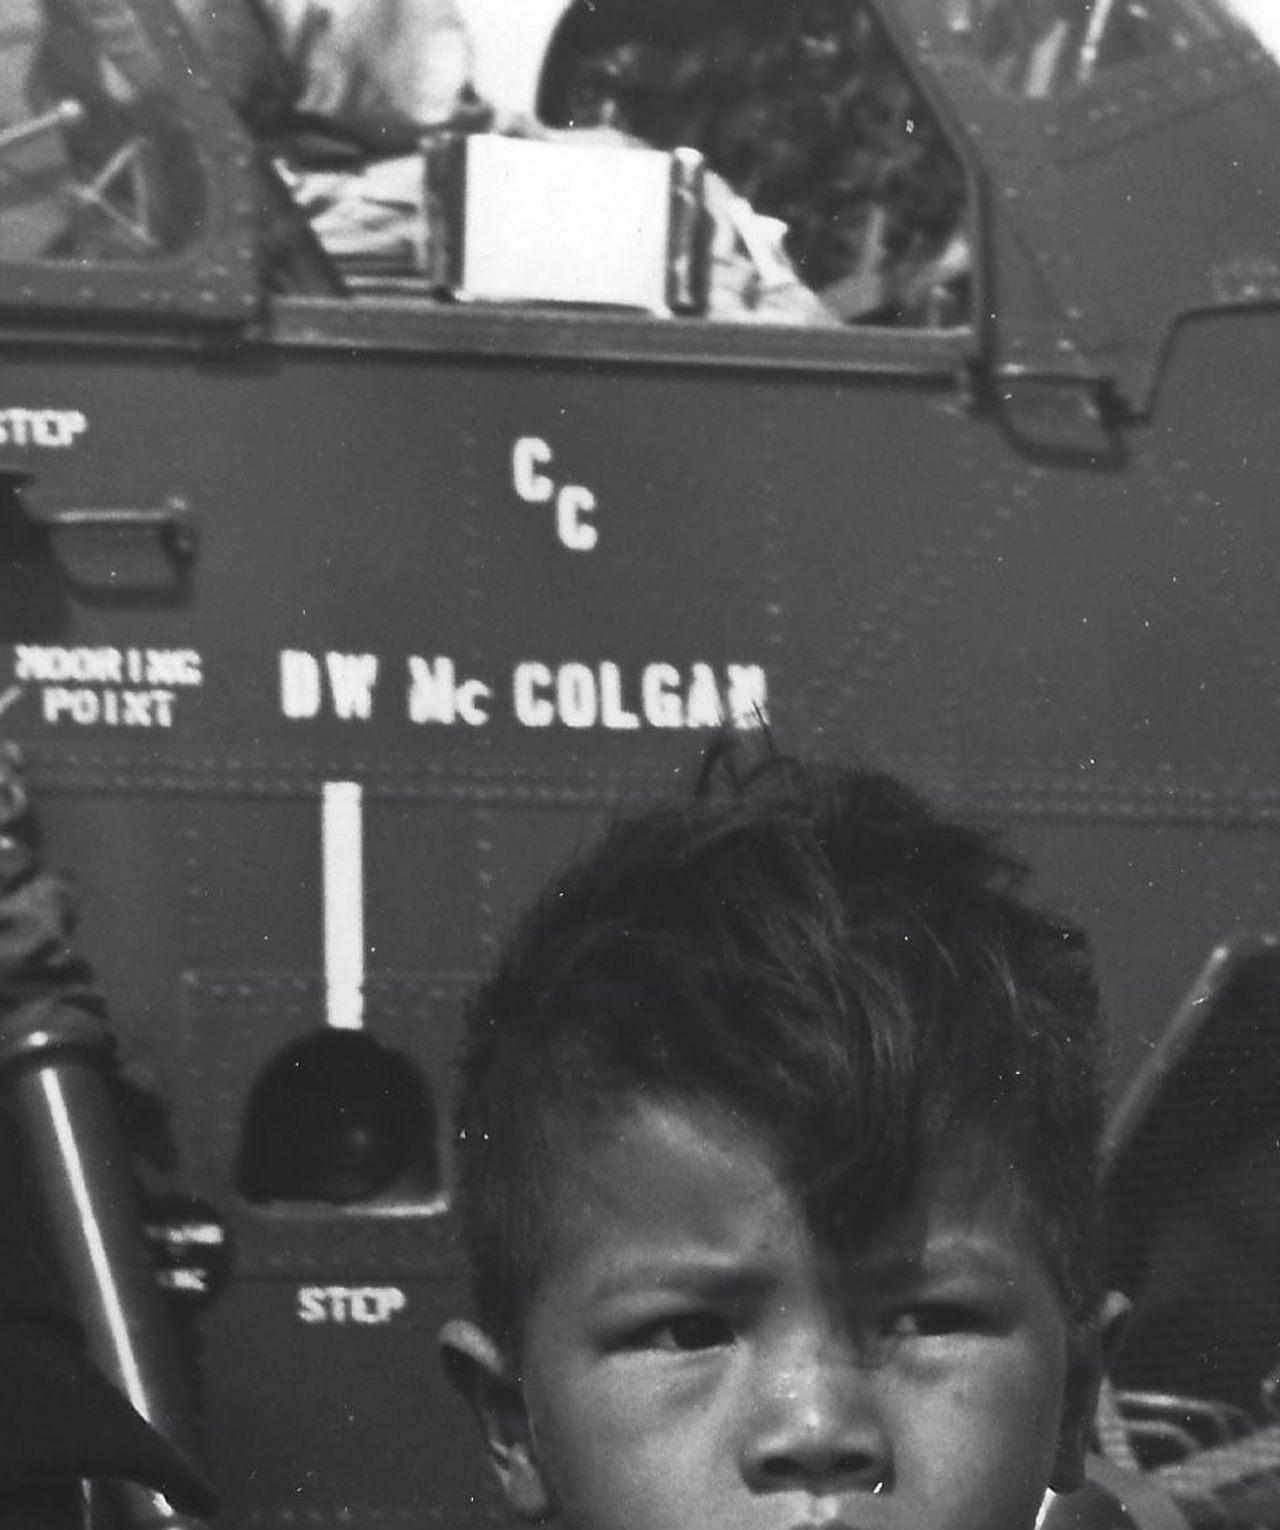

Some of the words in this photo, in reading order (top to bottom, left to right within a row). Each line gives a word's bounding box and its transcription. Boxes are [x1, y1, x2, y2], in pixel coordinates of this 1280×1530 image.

[14, 644, 204, 686] MOORING
[41, 686, 177, 728] POINT
[513, 661, 769, 731] COLGAN
[299, 1286, 405, 1324] STEP
